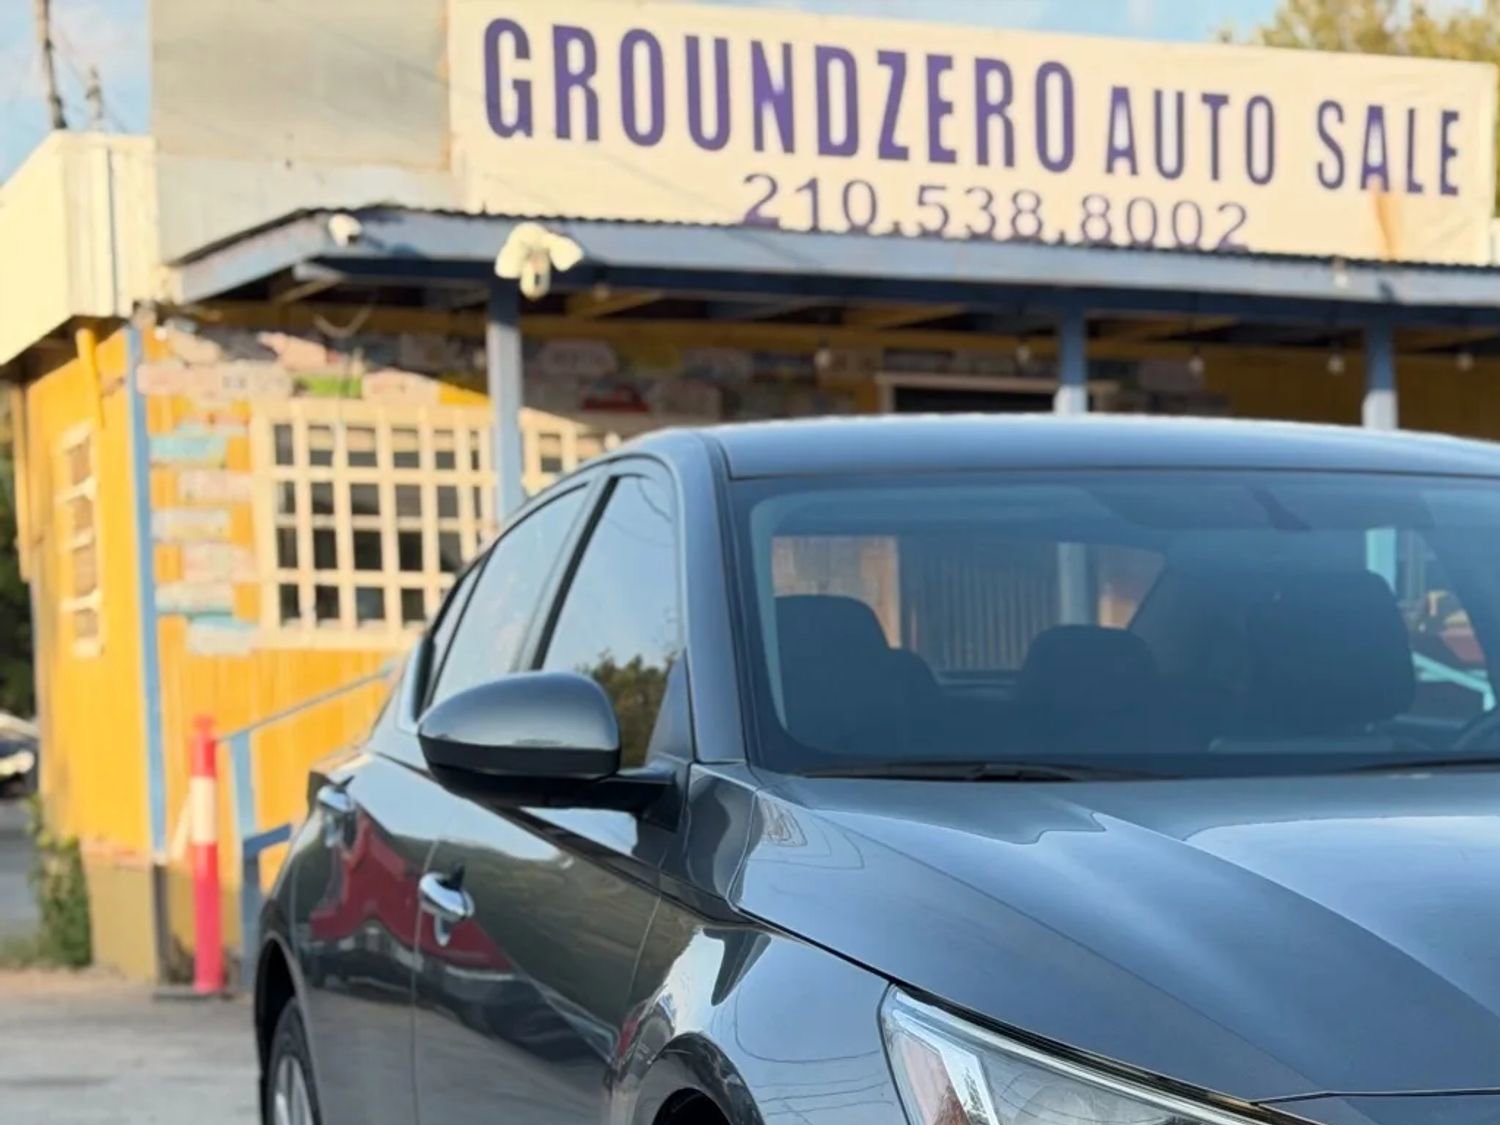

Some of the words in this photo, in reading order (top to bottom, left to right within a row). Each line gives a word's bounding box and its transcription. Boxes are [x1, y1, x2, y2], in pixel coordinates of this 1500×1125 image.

[483, 17, 1075, 173] GROUNDZERO
[1105, 85, 1275, 186] AUTO
[1316, 99, 1460, 196] SALE
[742, 172, 1250, 250] 210.538.8002
